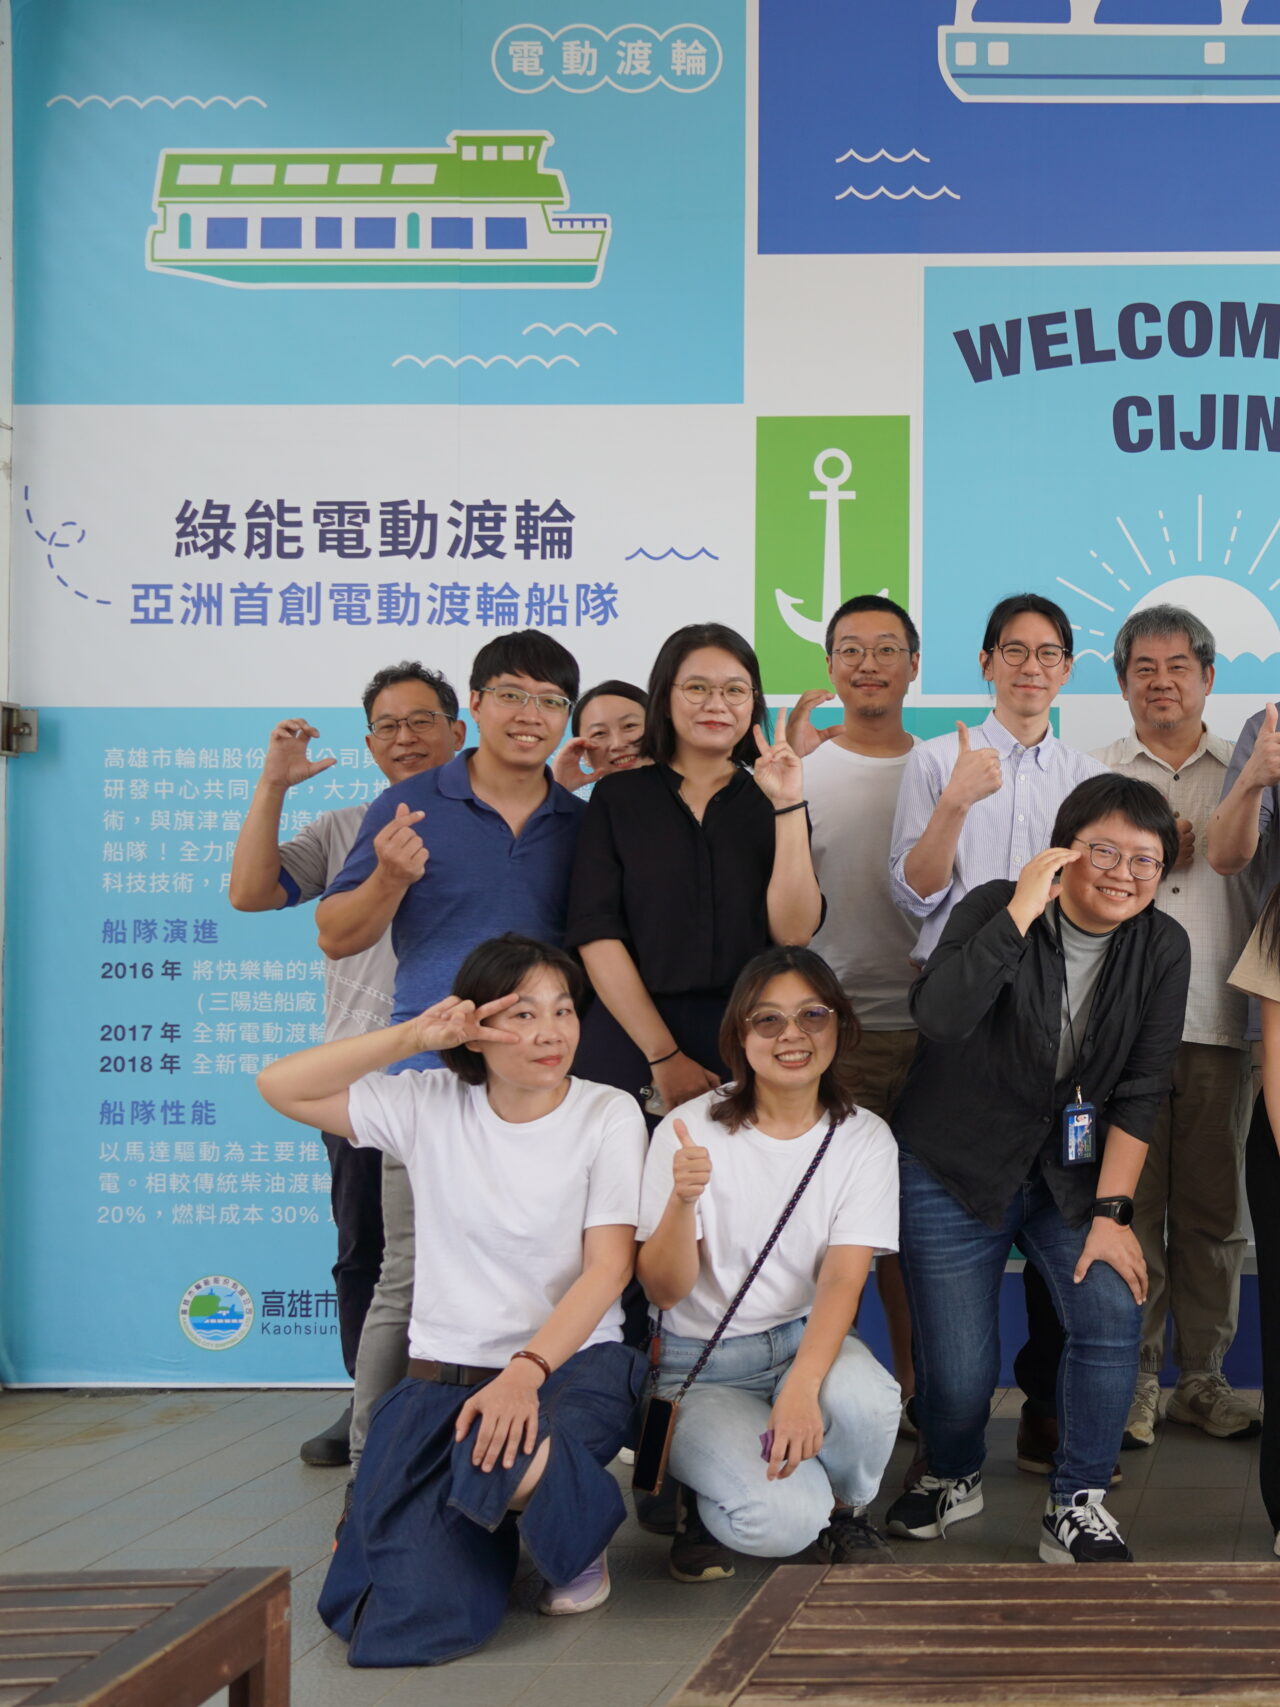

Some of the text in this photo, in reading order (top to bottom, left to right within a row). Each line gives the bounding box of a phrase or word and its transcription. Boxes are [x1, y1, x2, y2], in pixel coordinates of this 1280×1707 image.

[508, 39, 708, 77] 電動渡輪
[173, 498, 577, 561] 綠能電動渡輪
[130, 581, 620, 627] 亞洲首創電動渡輪船隊
[101, 918, 219, 944] 船隊演進
[101, 962, 154, 979] 2016
[161, 960, 183, 981] 年
[100, 1025, 153, 1042] 2017
[160, 1022, 182, 1043] 年
[99, 1056, 153, 1073] 2018
[160, 1053, 182, 1074] 年
[99, 1100, 217, 1126] 船隊性能
[98, 1141, 329, 1162] 以馬達驅動為主要推
[261, 1289, 338, 1318] 高雄市
